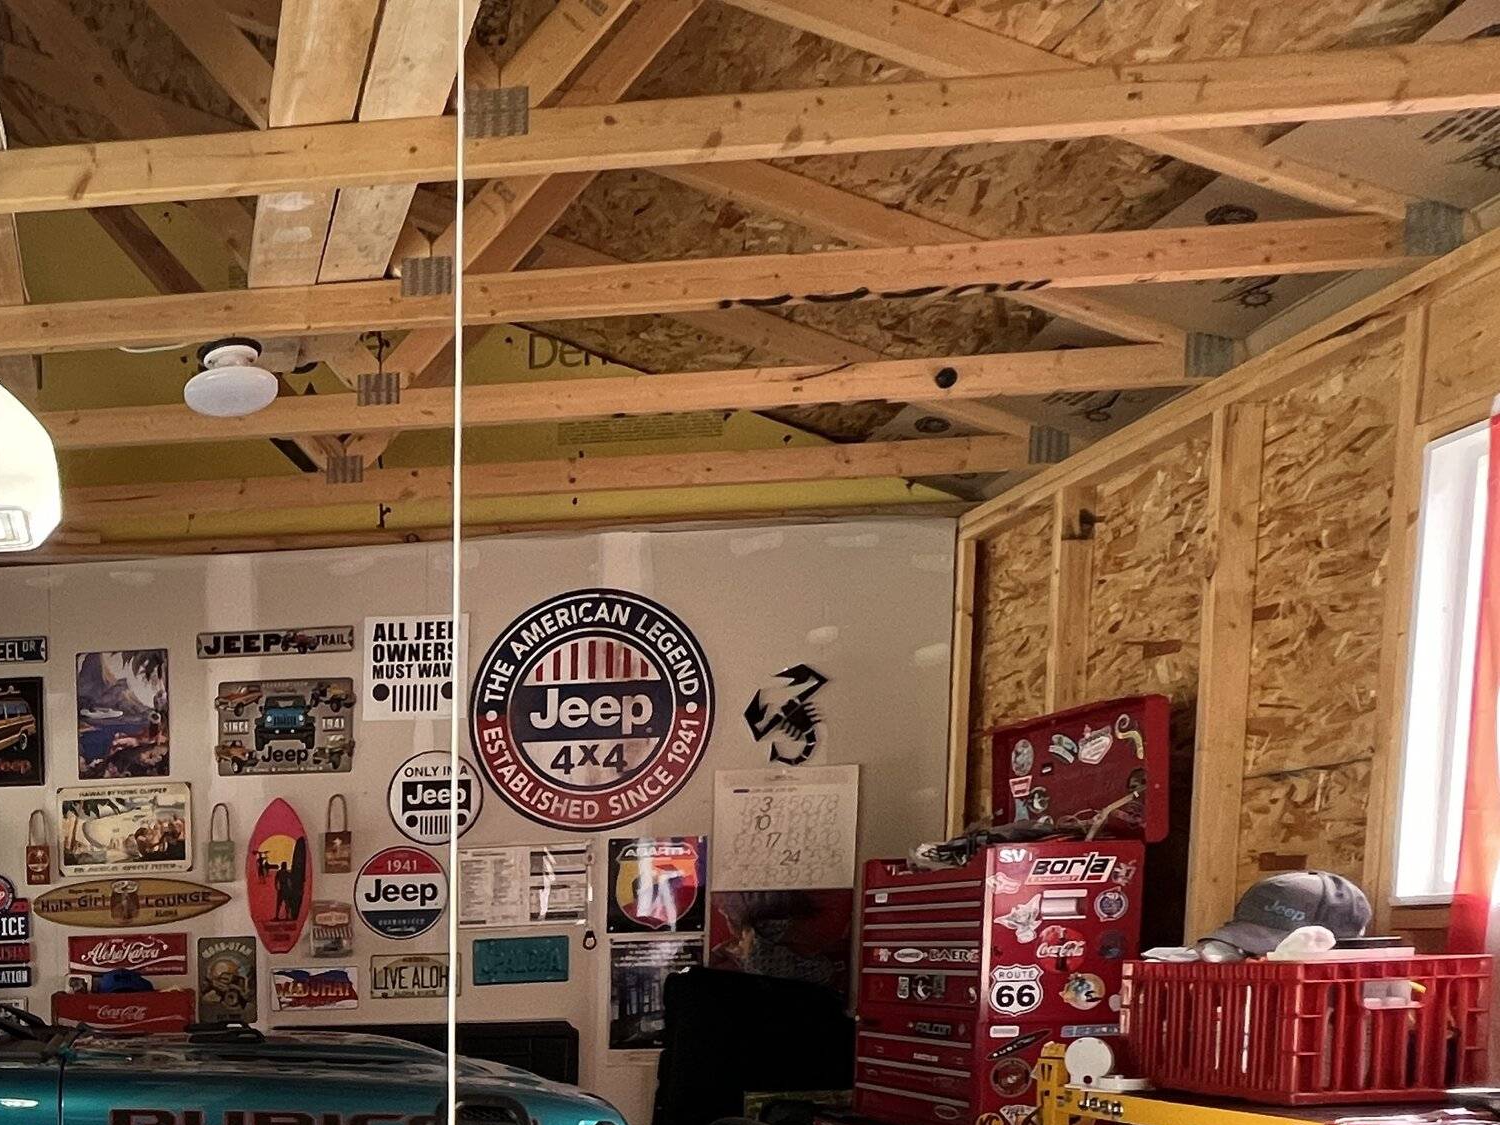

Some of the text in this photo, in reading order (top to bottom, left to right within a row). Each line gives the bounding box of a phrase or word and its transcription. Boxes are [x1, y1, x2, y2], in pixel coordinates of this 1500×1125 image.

[372, 622, 408, 642] ALL
[23, 641, 36, 653] DR
[203, 633, 347, 655] JEEP TRAIL
[484, 602, 700, 703] THE AMERICAN LEGEND
[372, 662, 452, 679] MUST WAV
[528, 688, 653, 735] Jeep
[222, 720, 249, 733] SINCE
[261, 746, 308, 767] Jeep
[404, 766, 440, 778] ONLY
[460, 765, 469, 776] A
[484, 718, 700, 820] ESTABLISHED SINCE 1941
[406, 784, 467, 805] Jeep
[387, 860, 418, 873] 1941
[40, 891, 212, 913] Hula Girl LOUNGE
[364, 878, 438, 907] Jeep
[1263, 900, 1306, 921] Jeep
[373, 966, 451, 990] LIVE ALOH
[999, 970, 1035, 979] ROUTE
[996, 985, 1036, 1008] 66
